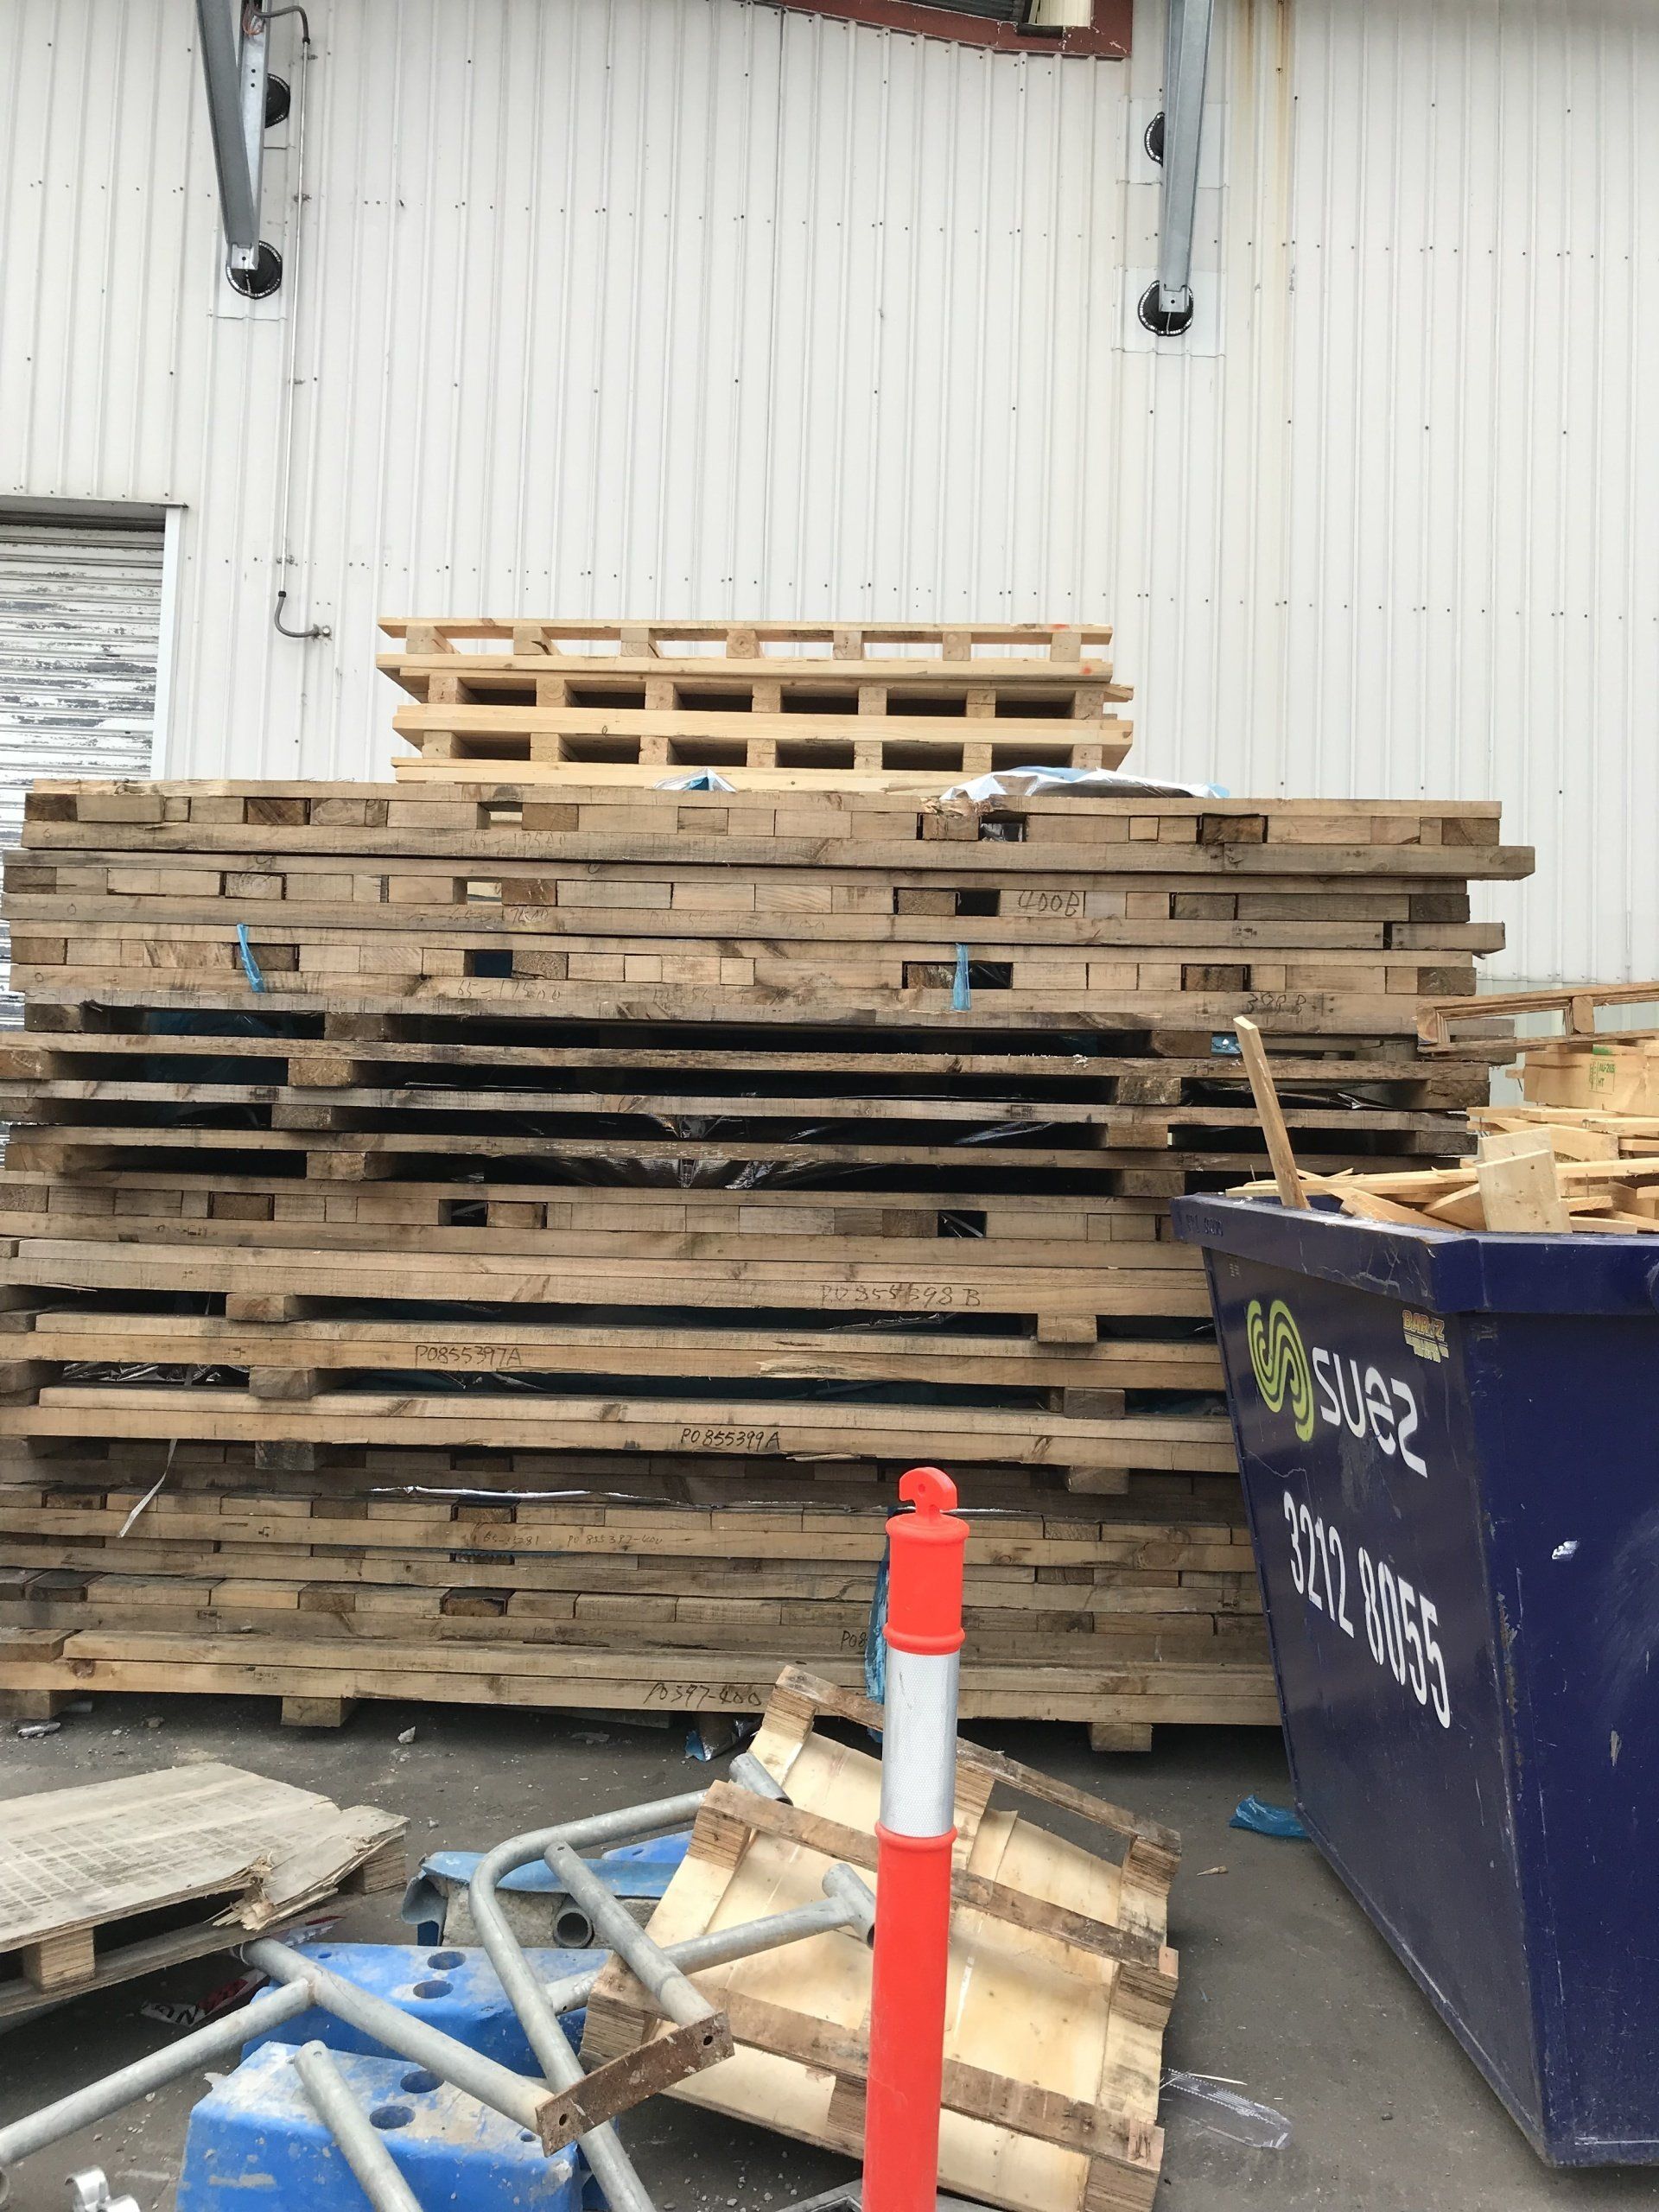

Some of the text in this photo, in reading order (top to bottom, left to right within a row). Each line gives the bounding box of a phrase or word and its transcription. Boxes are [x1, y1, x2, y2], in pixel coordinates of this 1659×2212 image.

[1312, 1346, 1427, 1479] suez
[1282, 1491, 1449, 1729] 3212 8055
